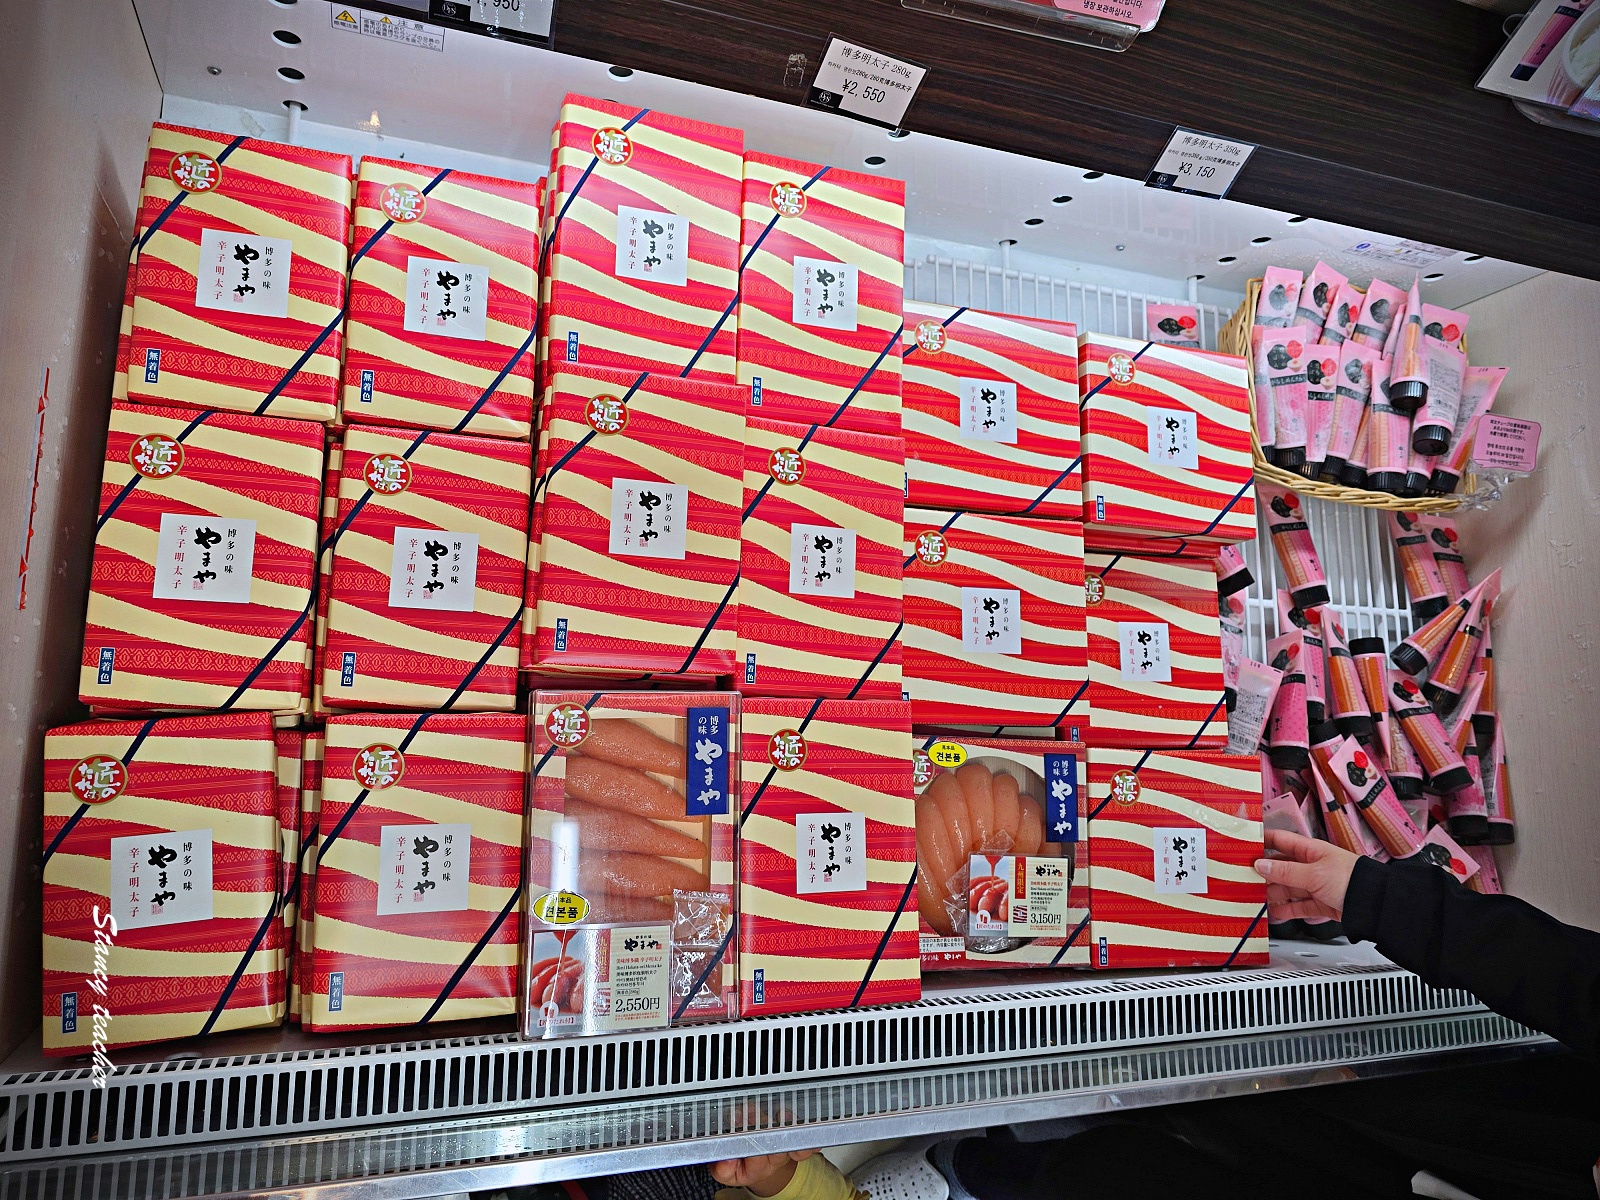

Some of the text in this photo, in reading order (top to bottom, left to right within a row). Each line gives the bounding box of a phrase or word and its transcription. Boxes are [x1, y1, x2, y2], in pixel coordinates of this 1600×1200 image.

[1083, 0, 1133, 19] 냉장 보관하십시오.
[841, 46, 912, 79] 博多明太子 280g
[1182, 135, 1241, 156] 博多明太子 350g
[628, 216, 637, 270] 辛子明太子
[643, 219, 664, 268] やまや
[666, 223, 674, 261] 博多の味
[214, 240, 227, 300] 辛子明太子
[233, 244, 260, 297] やまや
[262, 246, 273, 290] 博多の味
[419, 268, 431, 324] 辛子明太子
[436, 270, 460, 321] やまや
[463, 273, 473, 314] 博多の味
[804, 267, 812, 316] 辛子明太子
[816, 268, 836, 317] やまや
[147, 351, 159, 382] 無着色
[569, 333, 578, 361] 無着色
[362, 371, 373, 401] 無着色
[752, 379, 761, 405] 無着色
[980, 387, 997, 429] やまや
[1165, 416, 1180, 456] やまや
[623, 488, 634, 546] 辛子明太子
[638, 491, 662, 542] やまや
[663, 492, 673, 533] 博多の味
[171, 525, 188, 589] 辛子明太子
[192, 526, 222, 583] やまや
[224, 528, 237, 574] 博多の味
[405, 538, 418, 598] 辛子明太子
[423, 539, 449, 593] やまや
[450, 541, 462, 585] 博多の味
[801, 533, 810, 586] 辛子明太子
[813, 534, 833, 583] やまや
[835, 536, 844, 575] 博多の味
[556, 620, 567, 650] 無着色
[972, 596, 980, 645] 辛子明太子
[983, 596, 1000, 641] やまや
[100, 650, 113, 683] 無着色
[343, 655, 355, 685] 無着色
[746, 655, 755, 682] 無着色
[1137, 630, 1152, 670] やまや
[698, 715, 708, 735] の味
[710, 715, 719, 735] 博多
[695, 737, 723, 806] やまや
[936, 752, 961, 763] 견본품
[1051, 779, 1073, 835] やまや
[412, 835, 439, 895] やまや
[442, 834, 453, 882] 博多の味
[807, 823, 816, 884] 辛子明太子
[820, 822, 842, 876] やまや
[844, 822, 852, 865] 博多の味
[1173, 836, 1189, 881] やまや
[128, 847, 140, 918] 辛子明太子
[147, 843, 178, 907] やまや
[183, 841, 193, 892] 博多の味
[394, 836, 407, 904] 辛子明太子
[1036, 865, 1061, 877] やまや
[545, 906, 579, 919] 견본품
[1030, 913, 1062, 924] 3,150円
[624, 938, 659, 951] やまや
[330, 975, 342, 1010] 無着色
[615, 997, 660, 1012] 2,550円
[755, 971, 764, 1002] 無着色
[63, 995, 76, 1032] 無着色
